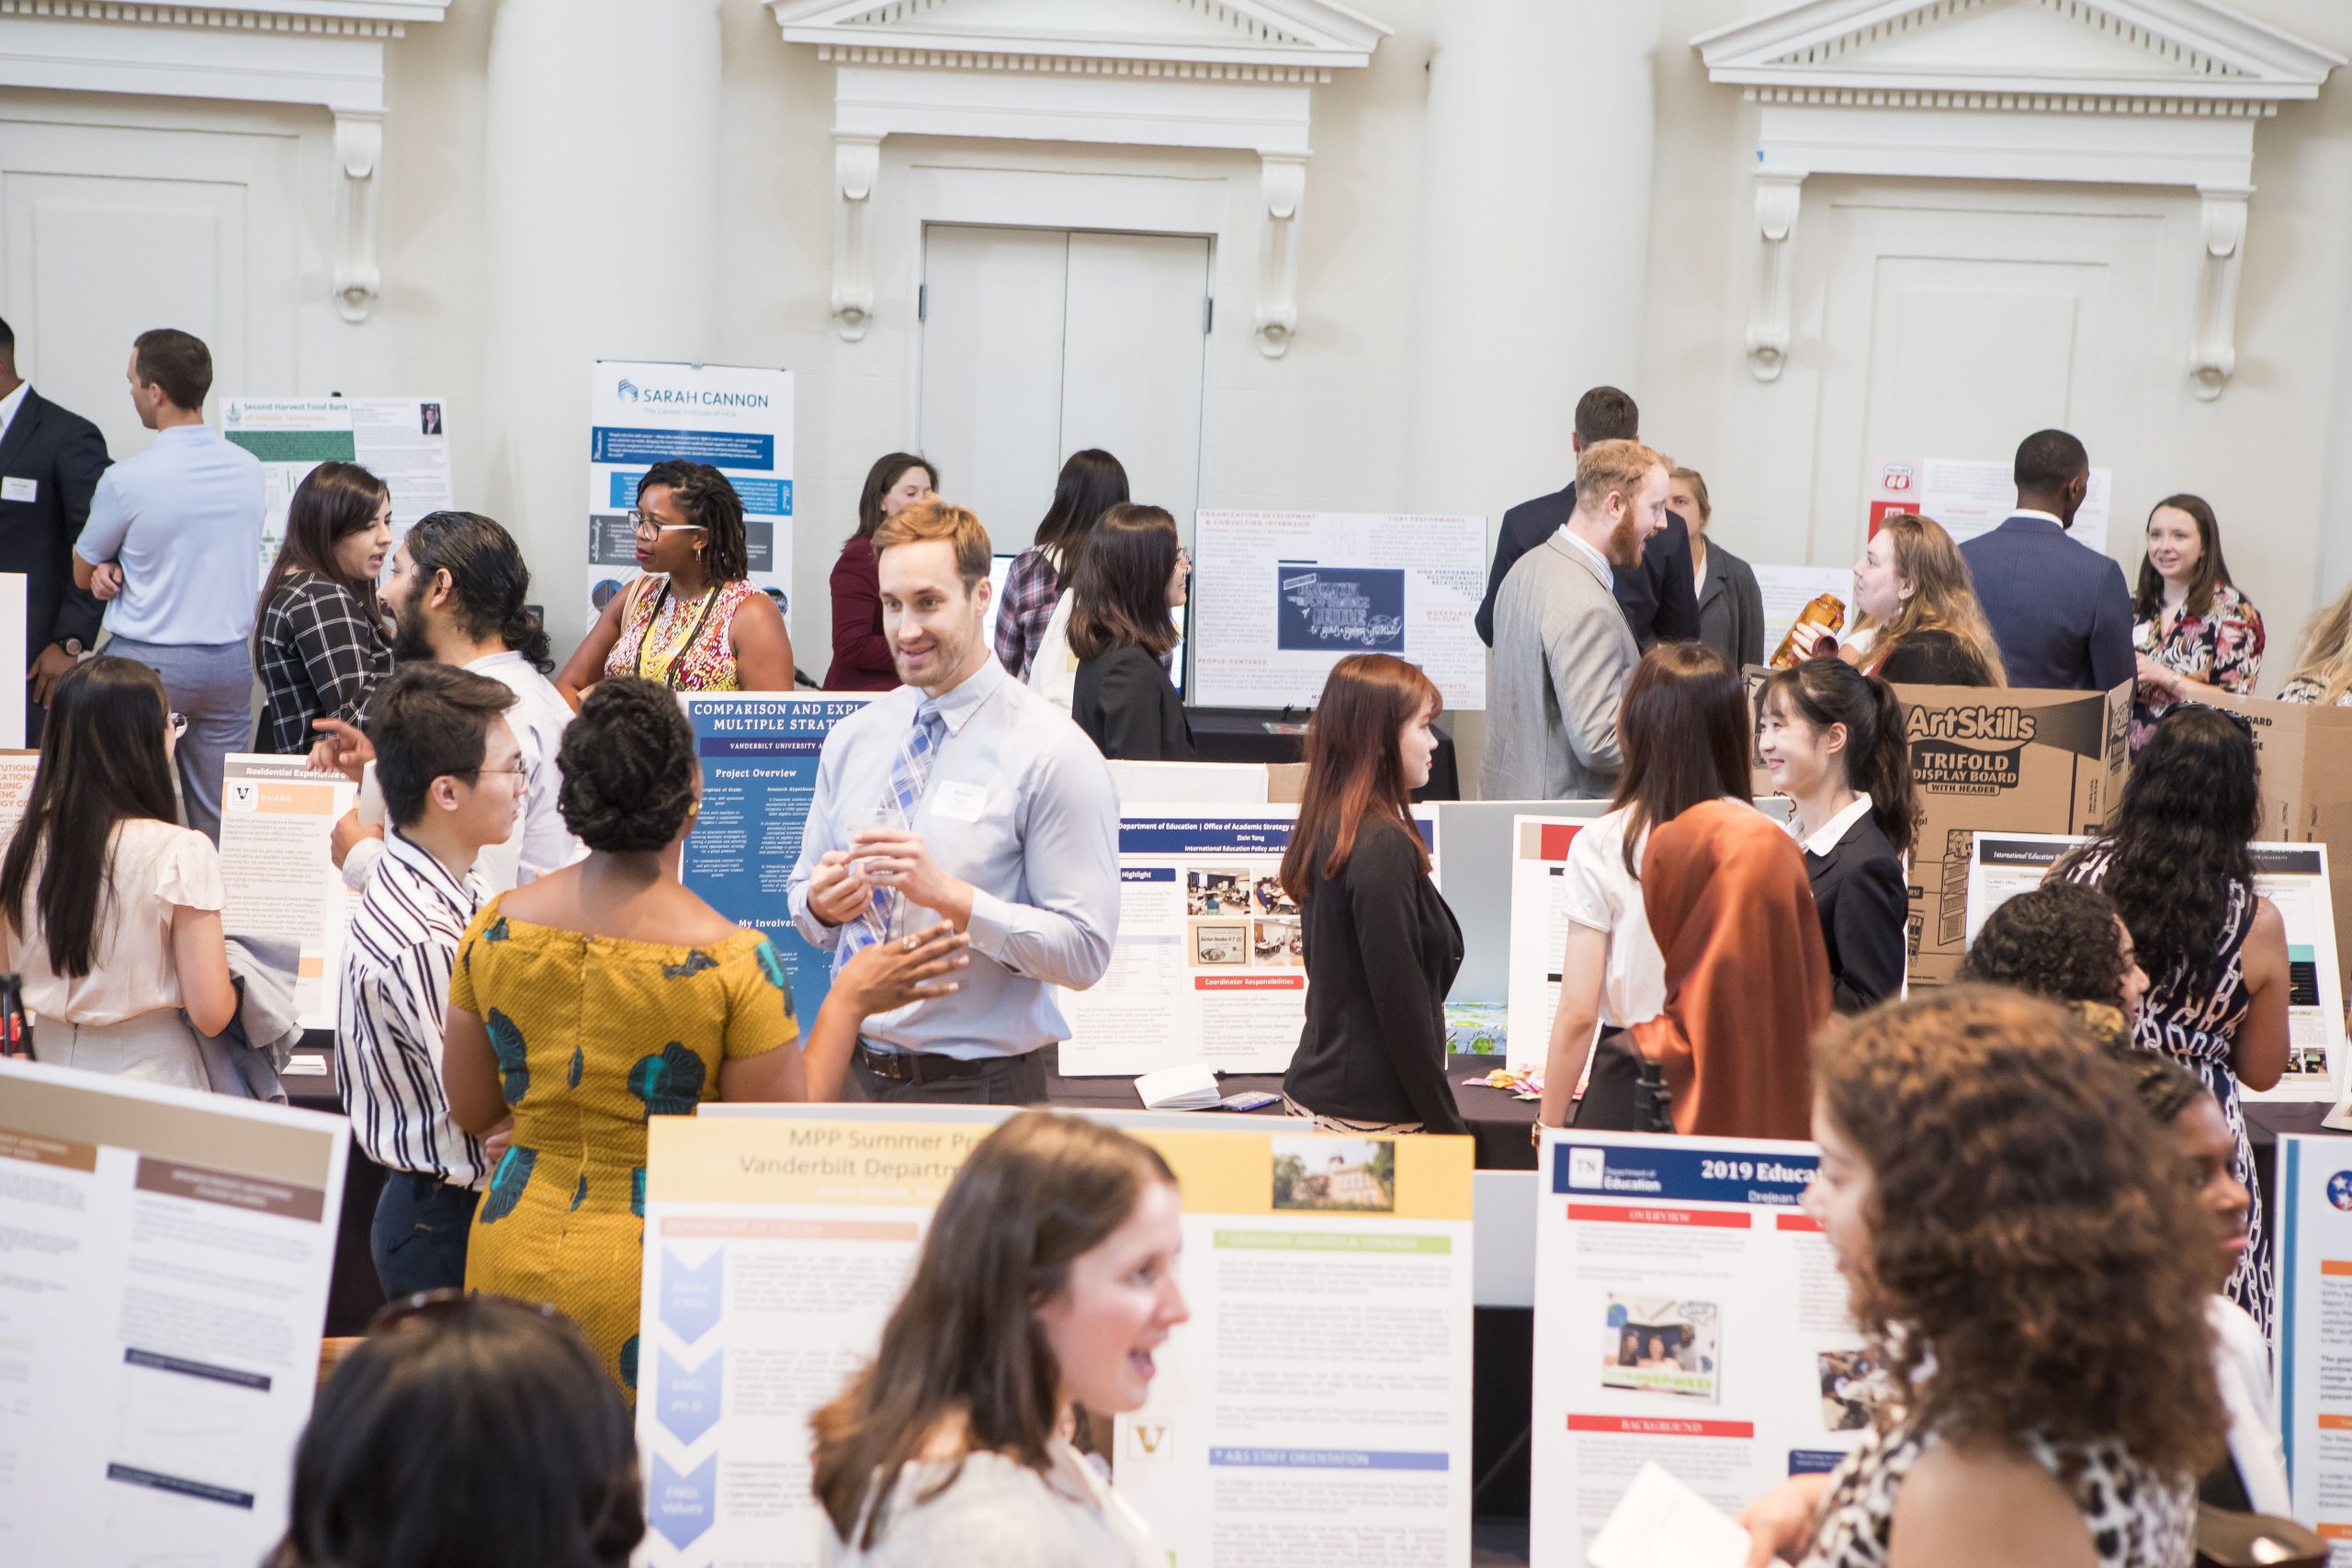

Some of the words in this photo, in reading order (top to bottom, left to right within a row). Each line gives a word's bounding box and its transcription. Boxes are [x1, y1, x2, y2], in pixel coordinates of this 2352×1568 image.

[644, 389, 697, 405] SARAH
[702, 391, 769, 408] CANNON
[1886, 474, 1909, 490] 66
[694, 704, 787, 716] COMPARISON
[792, 704, 822, 715] AND
[714, 719, 785, 731] MULTIPLE
[1906, 704, 2037, 741] ArtSkills
[1922, 752, 2009, 771] TRIFOLD
[246, 767, 293, 777] Residential
[716, 769, 750, 779] Project
[753, 769, 797, 778] Overview
[1913, 769, 1968, 781] DISPLAY
[1970, 771, 2017, 783] BOARD
[1932, 784, 1956, 793] WITH
[1959, 784, 1996, 794] HEADER
[1119, 823, 1157, 831] Department
[1263, 823, 1290, 832] Strategy
[1993, 851, 2028, 859] International
[1122, 871, 1152, 880] Highlight
[738, 919, 752, 929] My
[789, 1129, 841, 1148] MPP
[848, 1130, 943, 1149] Summer
[740, 1155, 856, 1177] Vanderbilt
[1575, 1159, 1596, 1173] TN
[1701, 1160, 1752, 1181] 2019
[1605, 1176, 1662, 1192] Education
[1629, 1210, 1690, 1222] OVERVIEW
[1621, 1418, 1702, 1433] BACKGROUND
[1253, 1451, 1287, 1464] STAFF
[1290, 1451, 1370, 1466] ORIENTATION
